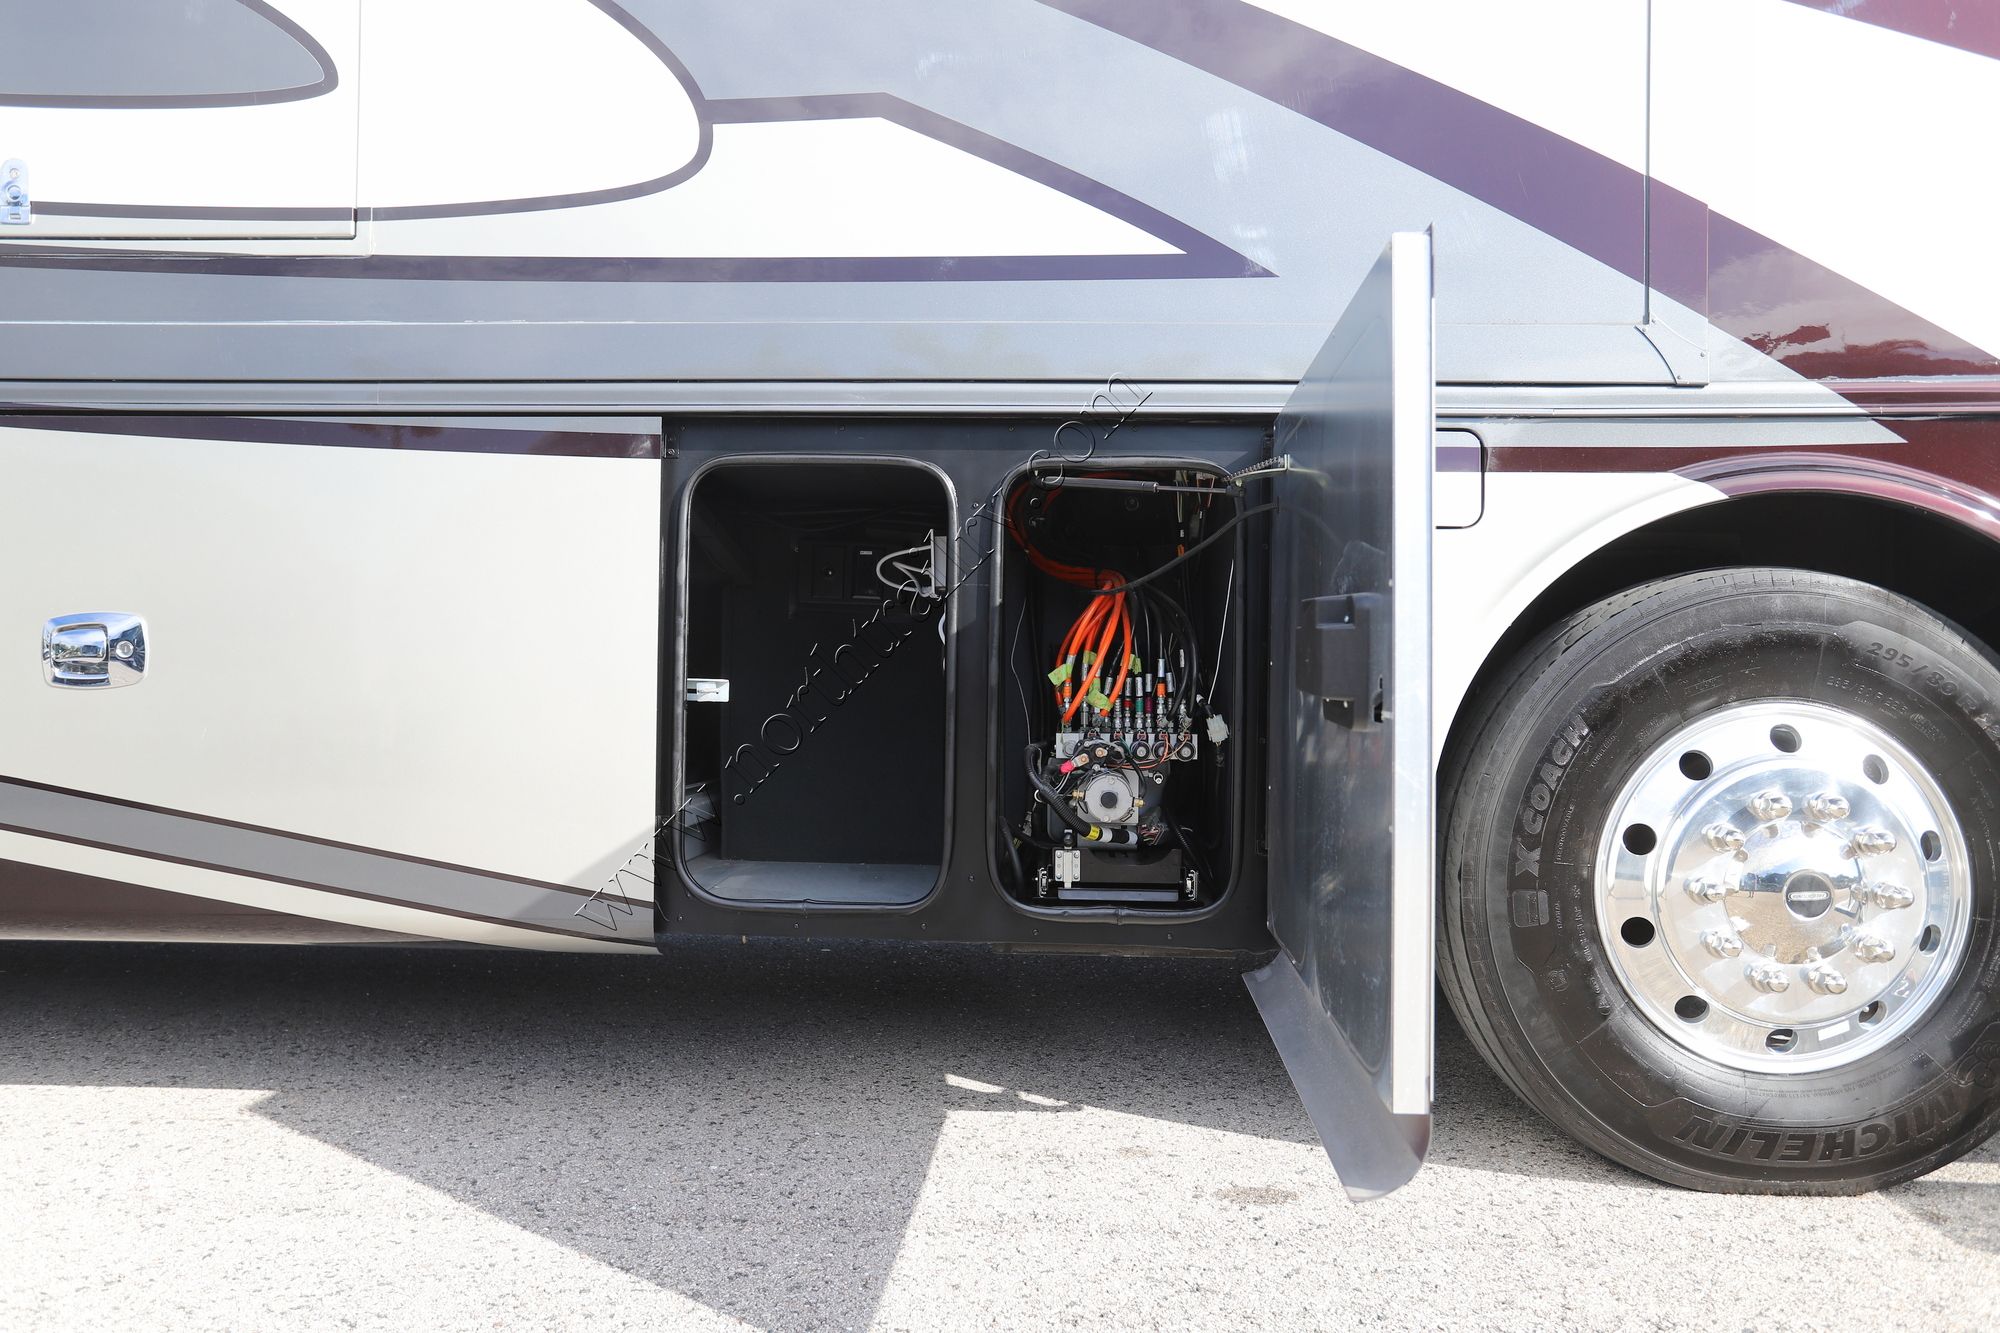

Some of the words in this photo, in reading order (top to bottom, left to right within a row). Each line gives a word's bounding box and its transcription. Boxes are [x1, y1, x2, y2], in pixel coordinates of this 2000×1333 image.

[1523, 713, 1591, 835] COACH
[1515, 841, 1542, 877] X
[1672, 1084, 1963, 1162] MICHELIN
